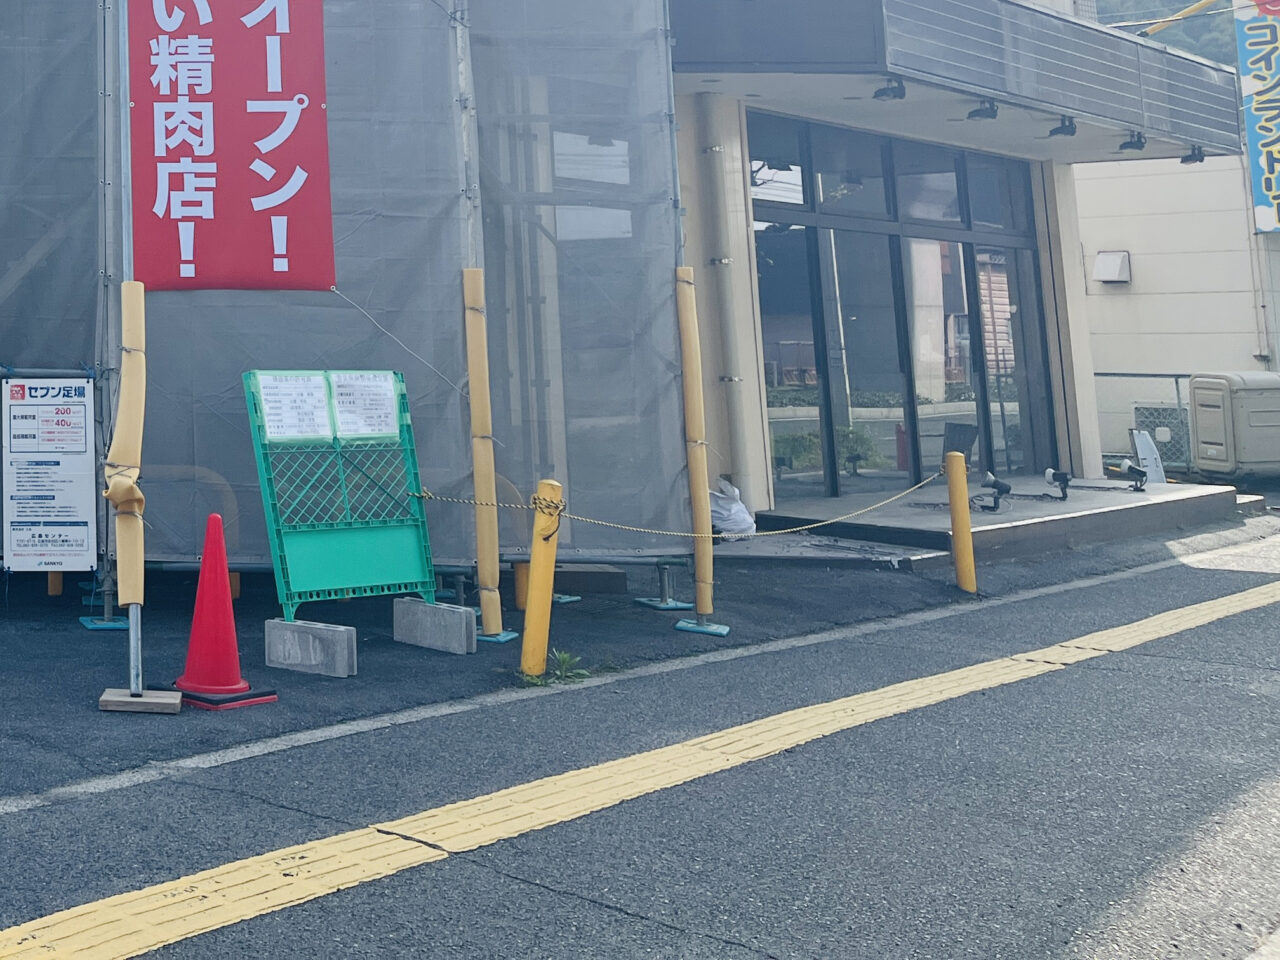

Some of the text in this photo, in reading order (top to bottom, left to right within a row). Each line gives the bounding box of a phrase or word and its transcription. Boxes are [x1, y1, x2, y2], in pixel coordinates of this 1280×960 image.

[28, 386, 86, 398] セブン足場
[55, 407, 71, 415] 200
